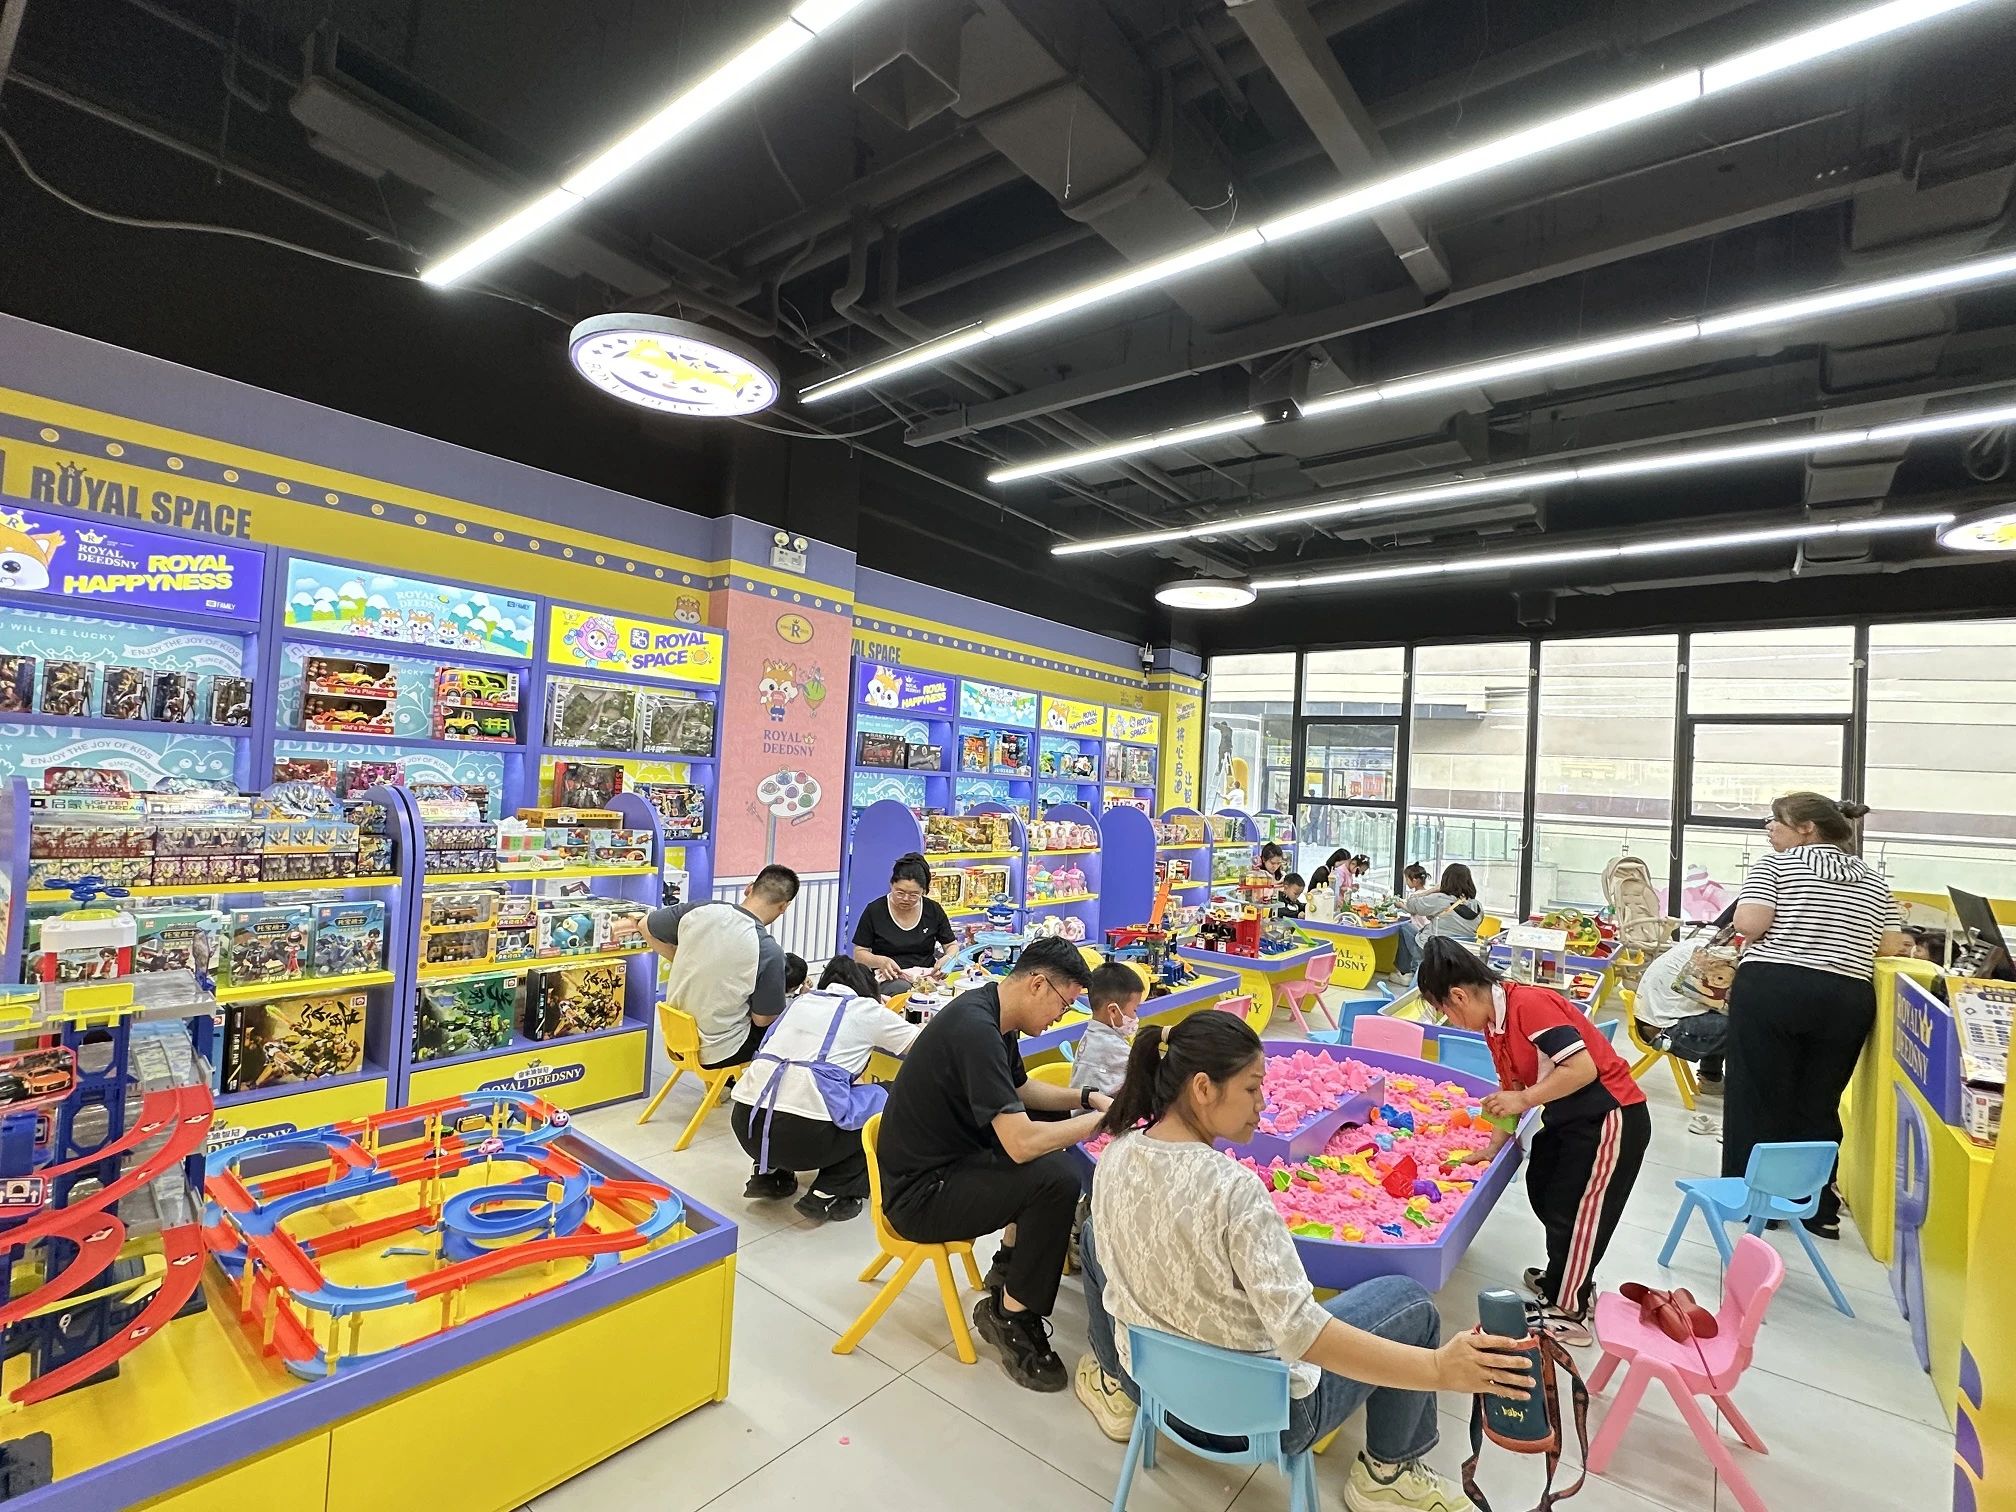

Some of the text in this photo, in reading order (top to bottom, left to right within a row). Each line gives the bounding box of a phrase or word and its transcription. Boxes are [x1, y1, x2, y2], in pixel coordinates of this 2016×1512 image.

[31, 464, 252, 540] ROYAL SPACE
[78, 543, 123, 559] ROYAL
[77, 552, 139, 570] DEEDSNY
[147, 554, 235, 573] ROYAL
[63, 573, 233, 594] HAPPYNESS
[11, 623, 44, 634] WILL
[50, 627, 67, 636] BE
[73, 629, 116, 642] LUCKY
[654, 632, 710, 649] ROYAL
[184, 637, 203, 645] JOY
[220, 641, 241, 658] KIDS
[868, 641, 901, 663] SPACE
[631, 650, 689, 670] SPACE
[922, 682, 947, 696] ROYAL
[901, 691, 947, 709] HAPPYNESS
[763, 729, 802, 743] ROYAL
[30, 740, 153, 765] ENJOY THE JOY OF KIDS
[762, 742, 815, 757] DEEDSNY
[1897, 992, 1920, 1039] ROYAL
[527, 1067, 582, 1088] DEEDSNY
[1501, 1405, 1524, 1422] baby
